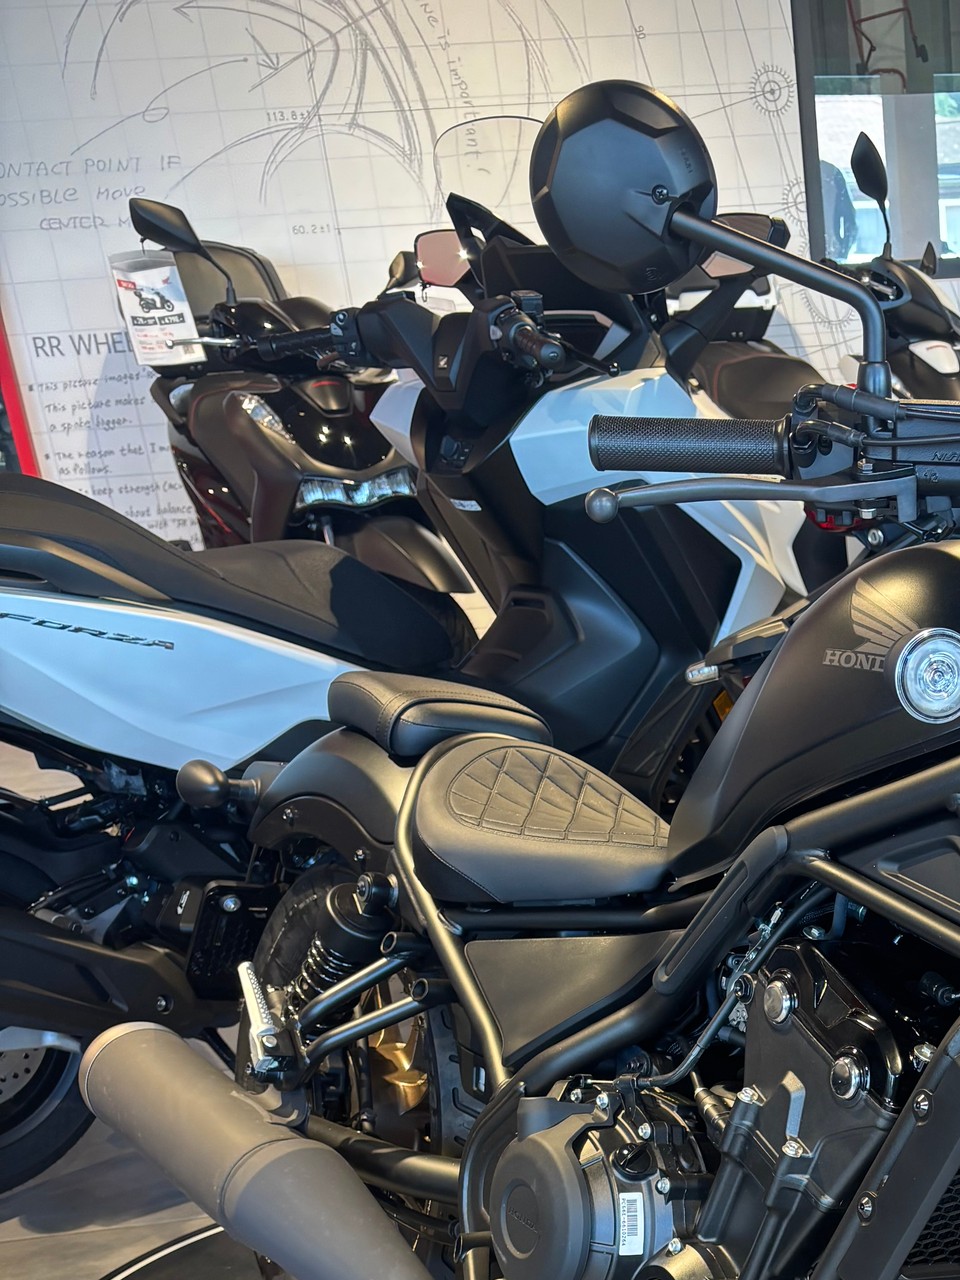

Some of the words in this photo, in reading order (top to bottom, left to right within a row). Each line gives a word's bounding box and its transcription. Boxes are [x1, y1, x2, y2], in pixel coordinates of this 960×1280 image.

[84, 156, 141, 174] POINT
[160, 155, 181, 170] IF
[119, 218, 132, 228] M
[32, 335, 65, 358] RR
[0, 612, 175, 651] FORZA
